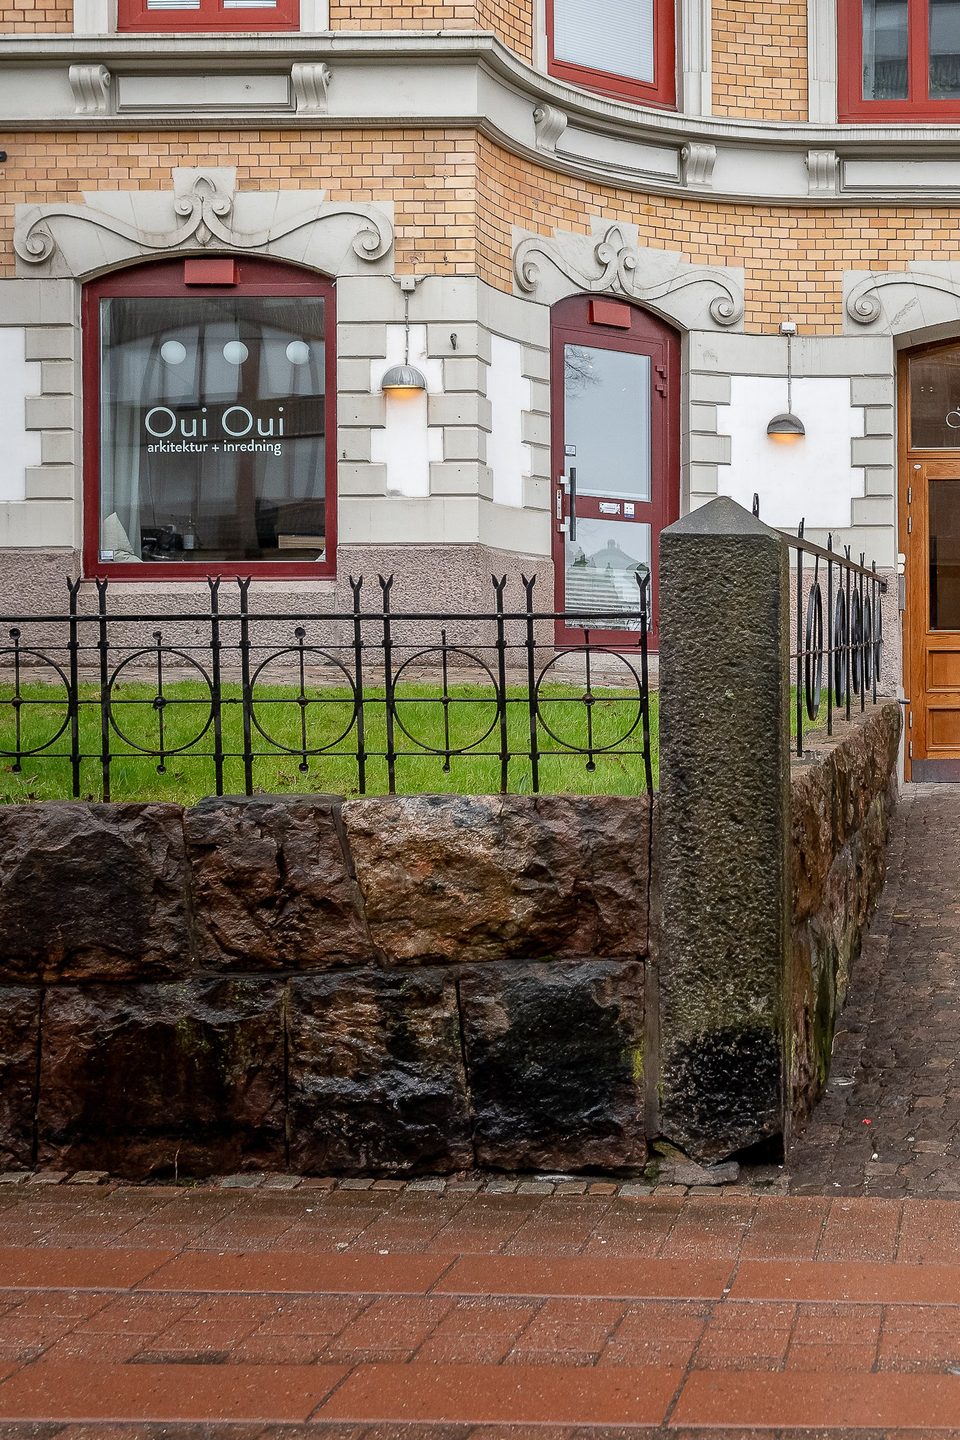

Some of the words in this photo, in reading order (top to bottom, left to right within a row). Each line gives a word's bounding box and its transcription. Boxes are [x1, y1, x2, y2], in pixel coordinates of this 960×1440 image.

[144, 406, 208, 438] Oui
[221, 405, 284, 437] Oui
[147, 439, 209, 453] arkitektur
[223, 439, 282, 456] inredning
